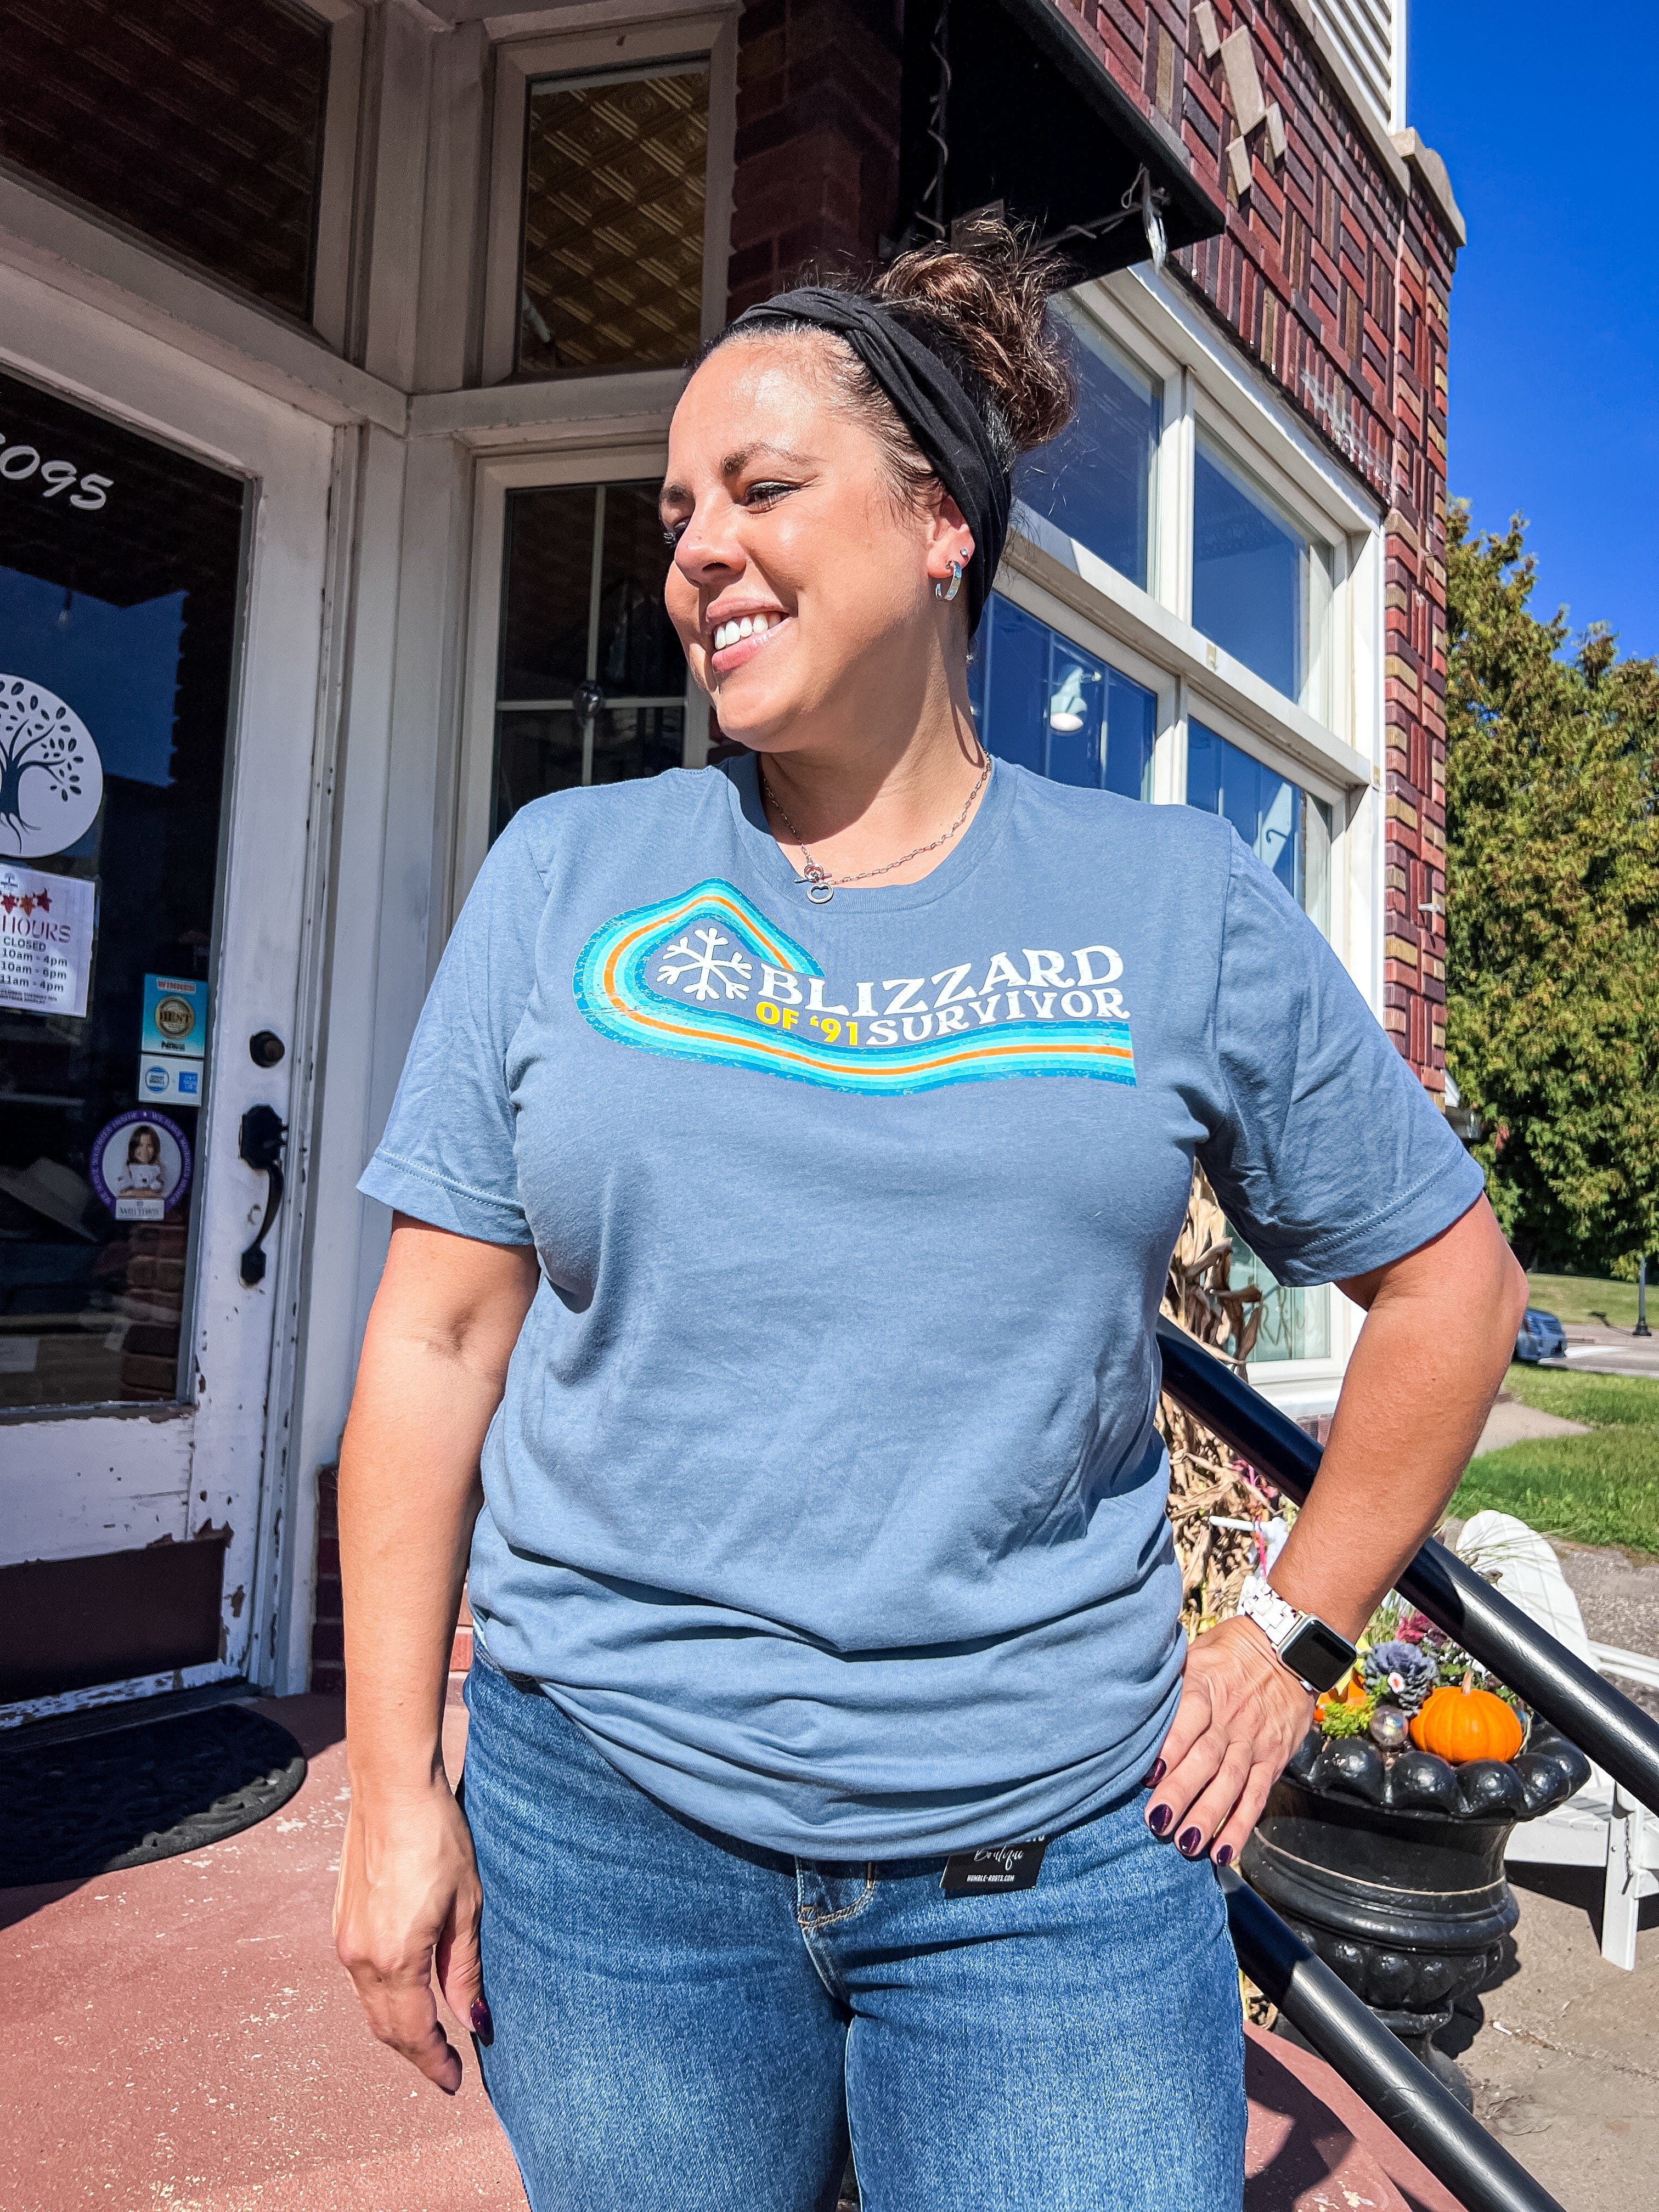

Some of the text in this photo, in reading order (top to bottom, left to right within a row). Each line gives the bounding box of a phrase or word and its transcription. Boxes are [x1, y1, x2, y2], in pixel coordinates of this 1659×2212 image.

[0, 433, 114, 510] 095
[2, 915, 71, 943] HOURS
[3, 936, 46, 952] CLOSED
[1, 962, 32, 974] 10am
[2, 948, 33, 961] 10am
[43, 955, 67, 967] 4pm
[0, 974, 29, 988] 11am
[40, 981, 64, 992] 4pm
[758, 945, 1125, 1018] BLIZZARD
[755, 1002, 799, 1030] OF
[866, 988, 1130, 1046] SURVIVOR
